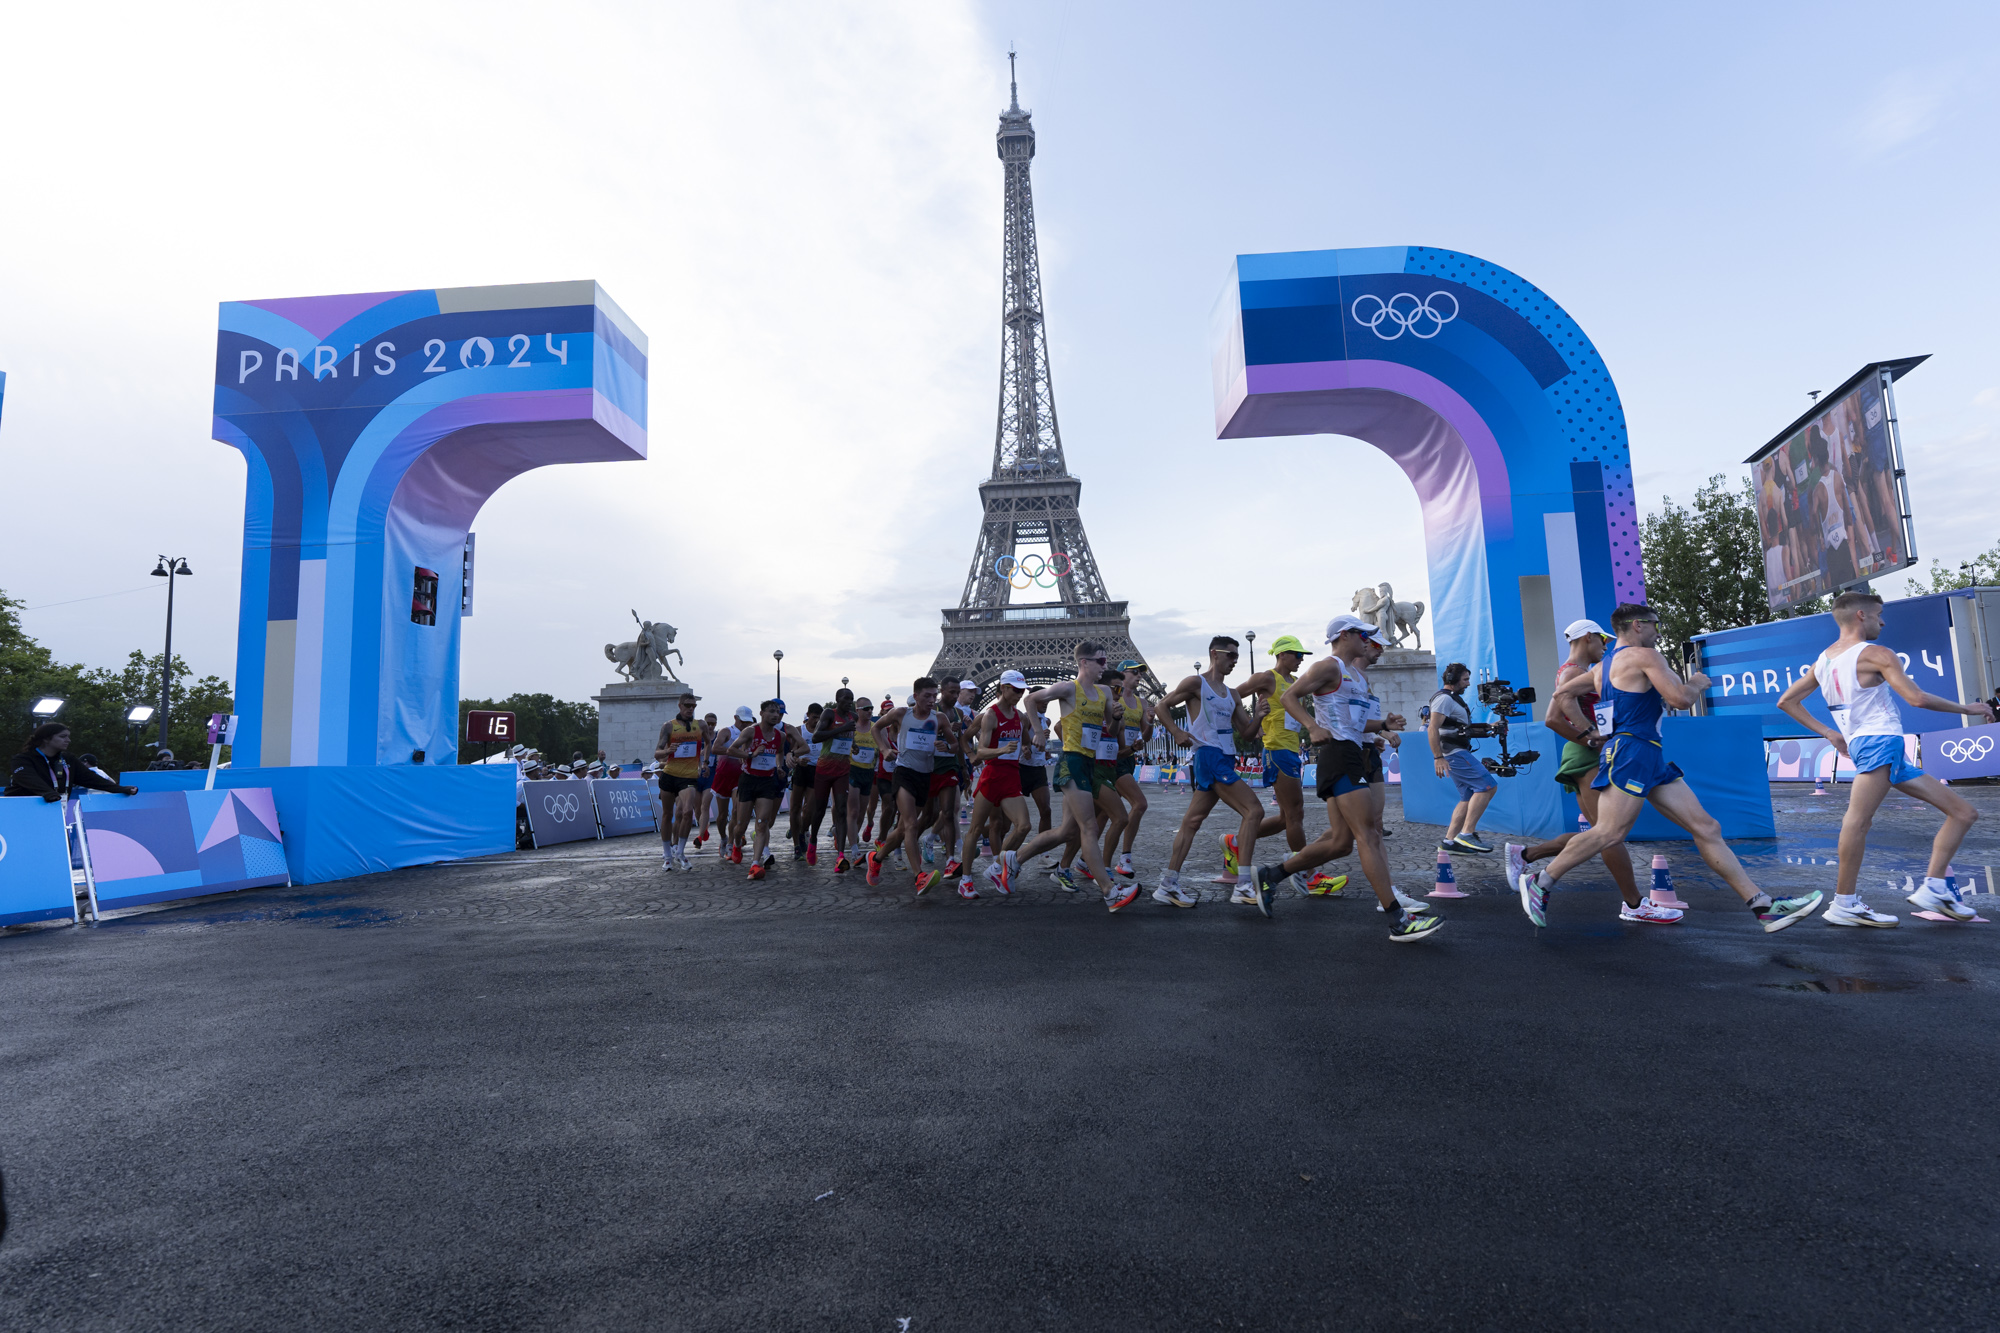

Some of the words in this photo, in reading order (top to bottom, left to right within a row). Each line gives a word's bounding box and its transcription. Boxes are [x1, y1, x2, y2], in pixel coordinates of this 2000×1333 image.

[423, 332, 568, 374] 2024
[1870, 409, 1878, 421] 36
[1831, 531, 1840, 543] 48
[488, 716, 508, 736] 16
[1000, 730, 1021, 739] CHINA
[1091, 731, 1098, 739] 12
[1106, 743, 1114, 751] 65
[612, 805, 642, 820] 2024
